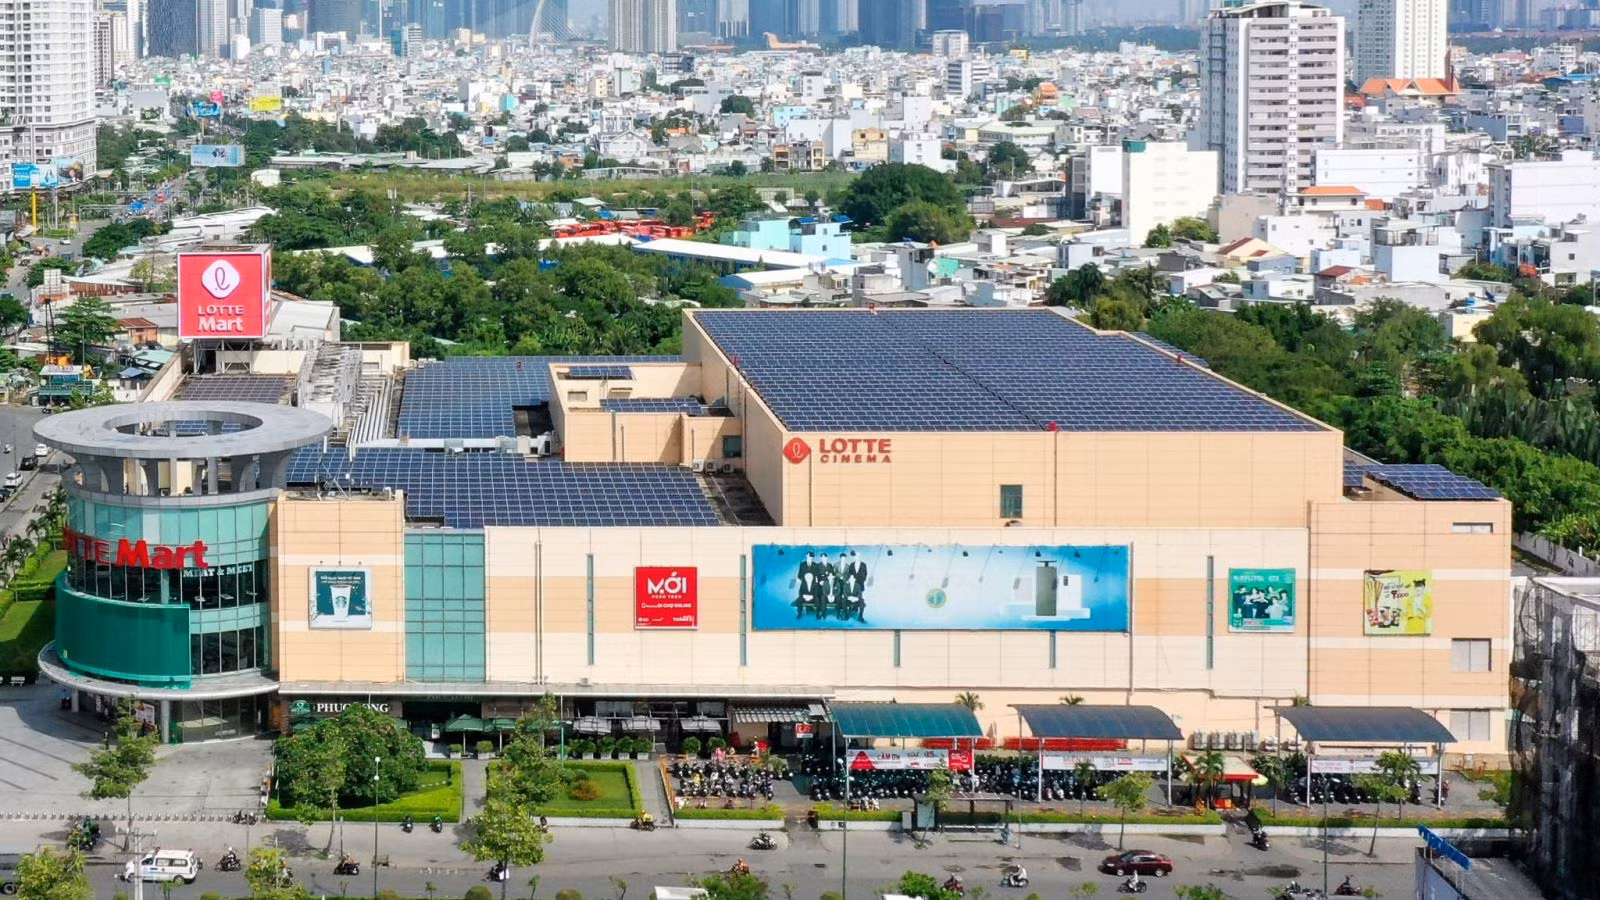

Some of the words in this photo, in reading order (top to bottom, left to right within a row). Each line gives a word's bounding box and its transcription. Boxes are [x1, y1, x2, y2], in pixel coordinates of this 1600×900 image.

[197, 304, 244, 316] LOTTE
[198, 316, 244, 333] Mart
[819, 438, 892, 454] LOTTE
[820, 454, 892, 464] CINEMA
[117, 537, 209, 569] Mart
[183, 568, 215, 577] MEAT
[217, 567, 225, 576] &
[226, 564, 253, 575] MEET
[647, 571, 687, 594] MỚI
[361, 703, 390, 713] ONG
